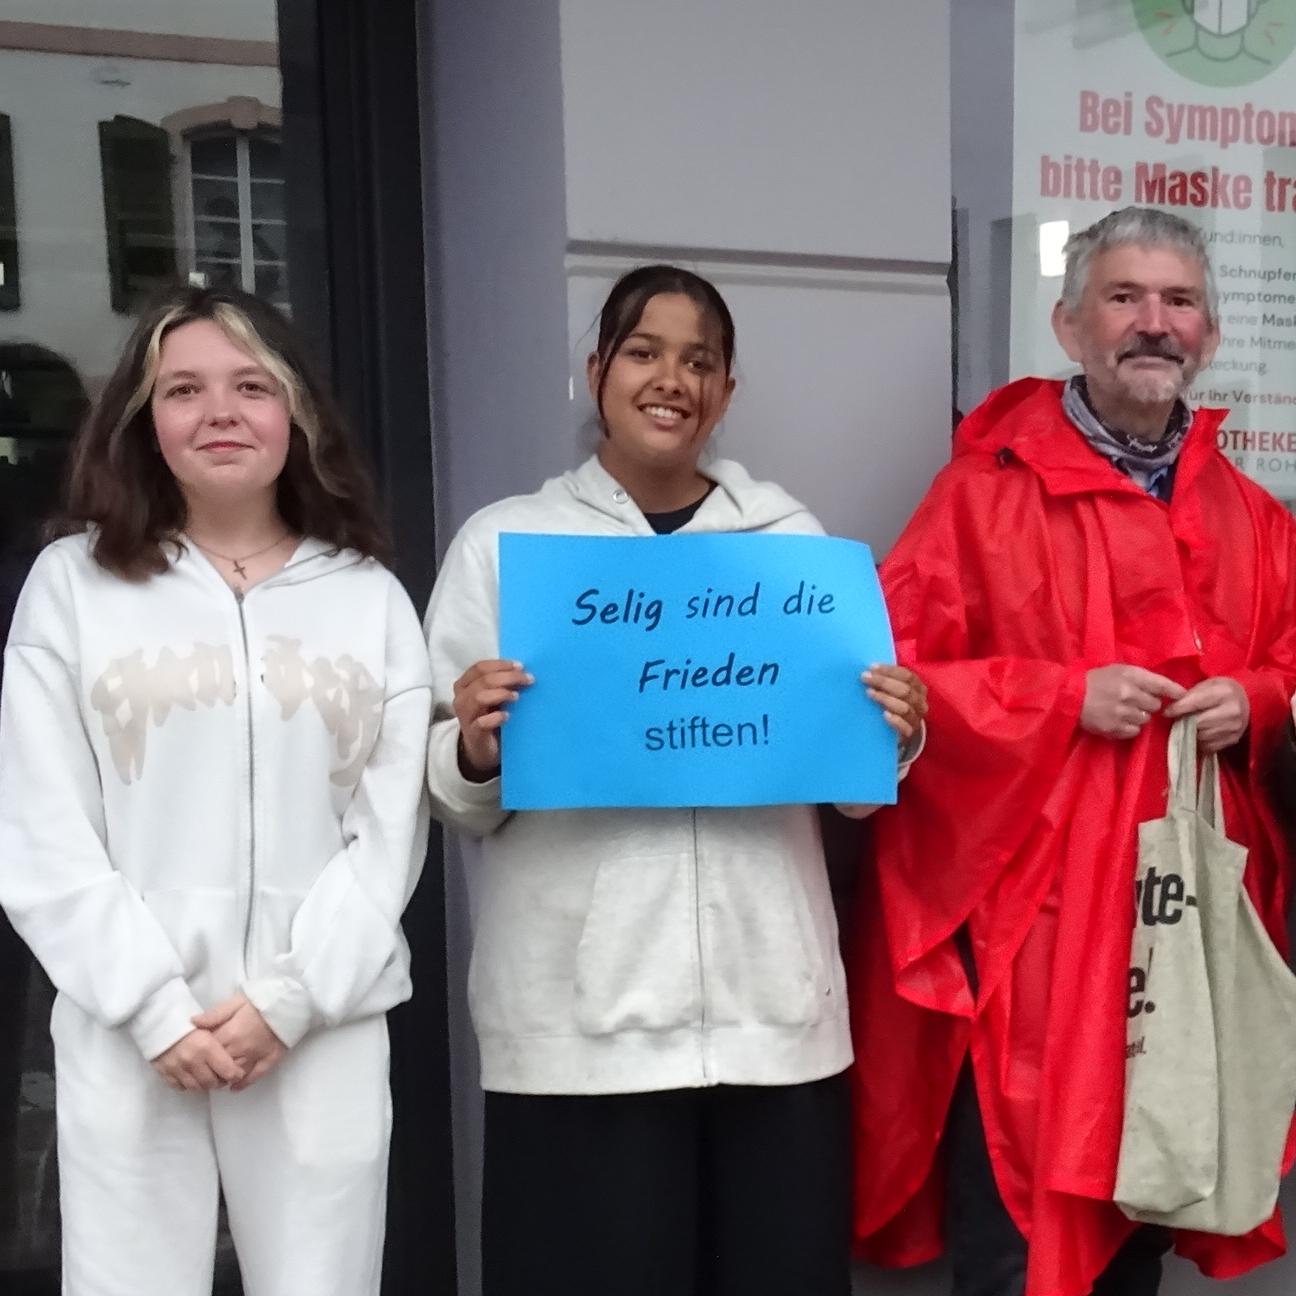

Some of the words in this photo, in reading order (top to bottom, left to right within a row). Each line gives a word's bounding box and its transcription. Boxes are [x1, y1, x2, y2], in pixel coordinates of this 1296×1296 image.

[1079, 90, 1132, 135] Bei
[1040, 155, 1123, 202] bitte
[1134, 162, 1252, 210] Maske
[1218, 291, 1296, 305] ymptome
[1227, 314, 1258, 326] eine
[1221, 336, 1245, 349] hre
[1256, 457, 1296, 472] ROH
[571, 588, 662, 631] Selig
[686, 582, 761, 619] sind
[783, 581, 835, 615] die
[638, 652, 780, 693] Frieden
[645, 714, 769, 751] stiften!
